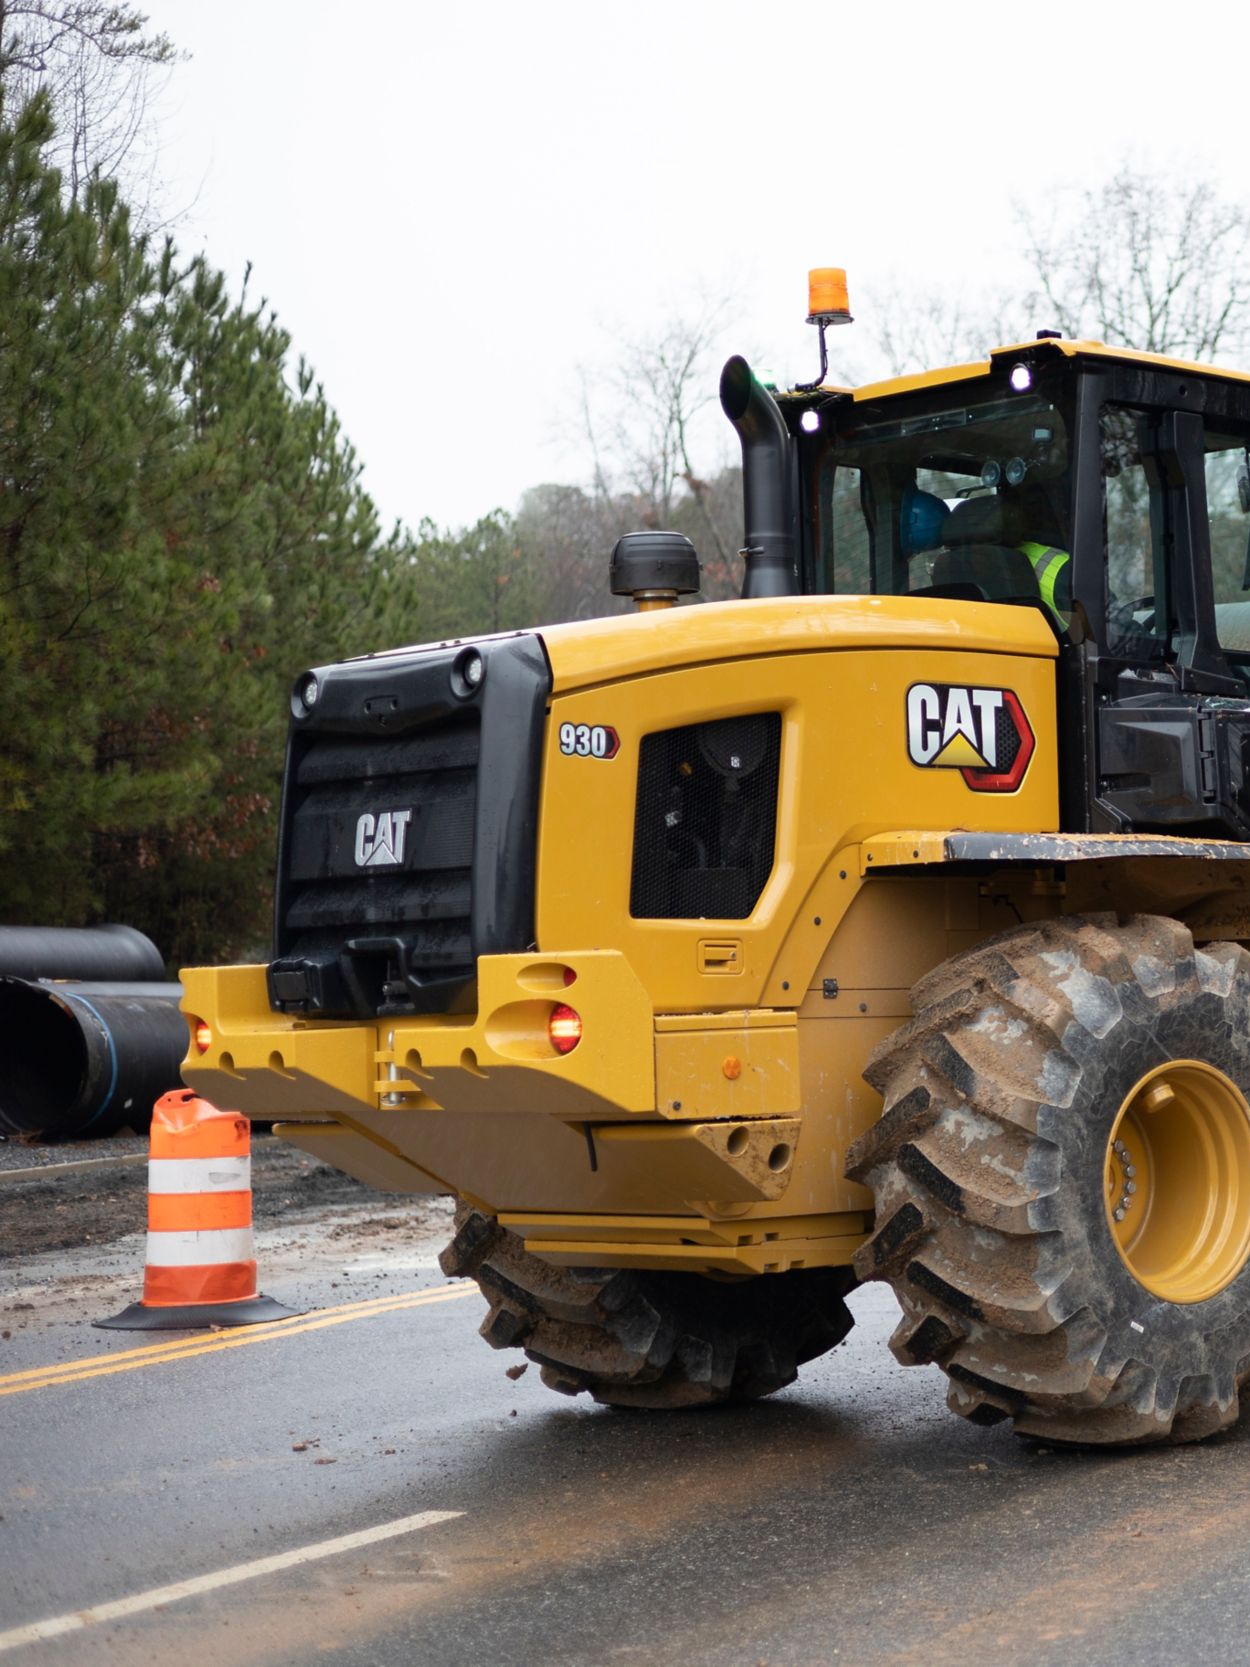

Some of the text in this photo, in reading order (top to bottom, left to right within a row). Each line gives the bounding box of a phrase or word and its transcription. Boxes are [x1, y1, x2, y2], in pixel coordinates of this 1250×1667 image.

[560, 723, 606, 757] 930
[907, 684, 1003, 768] CAT
[354, 808, 412, 867] CAT
